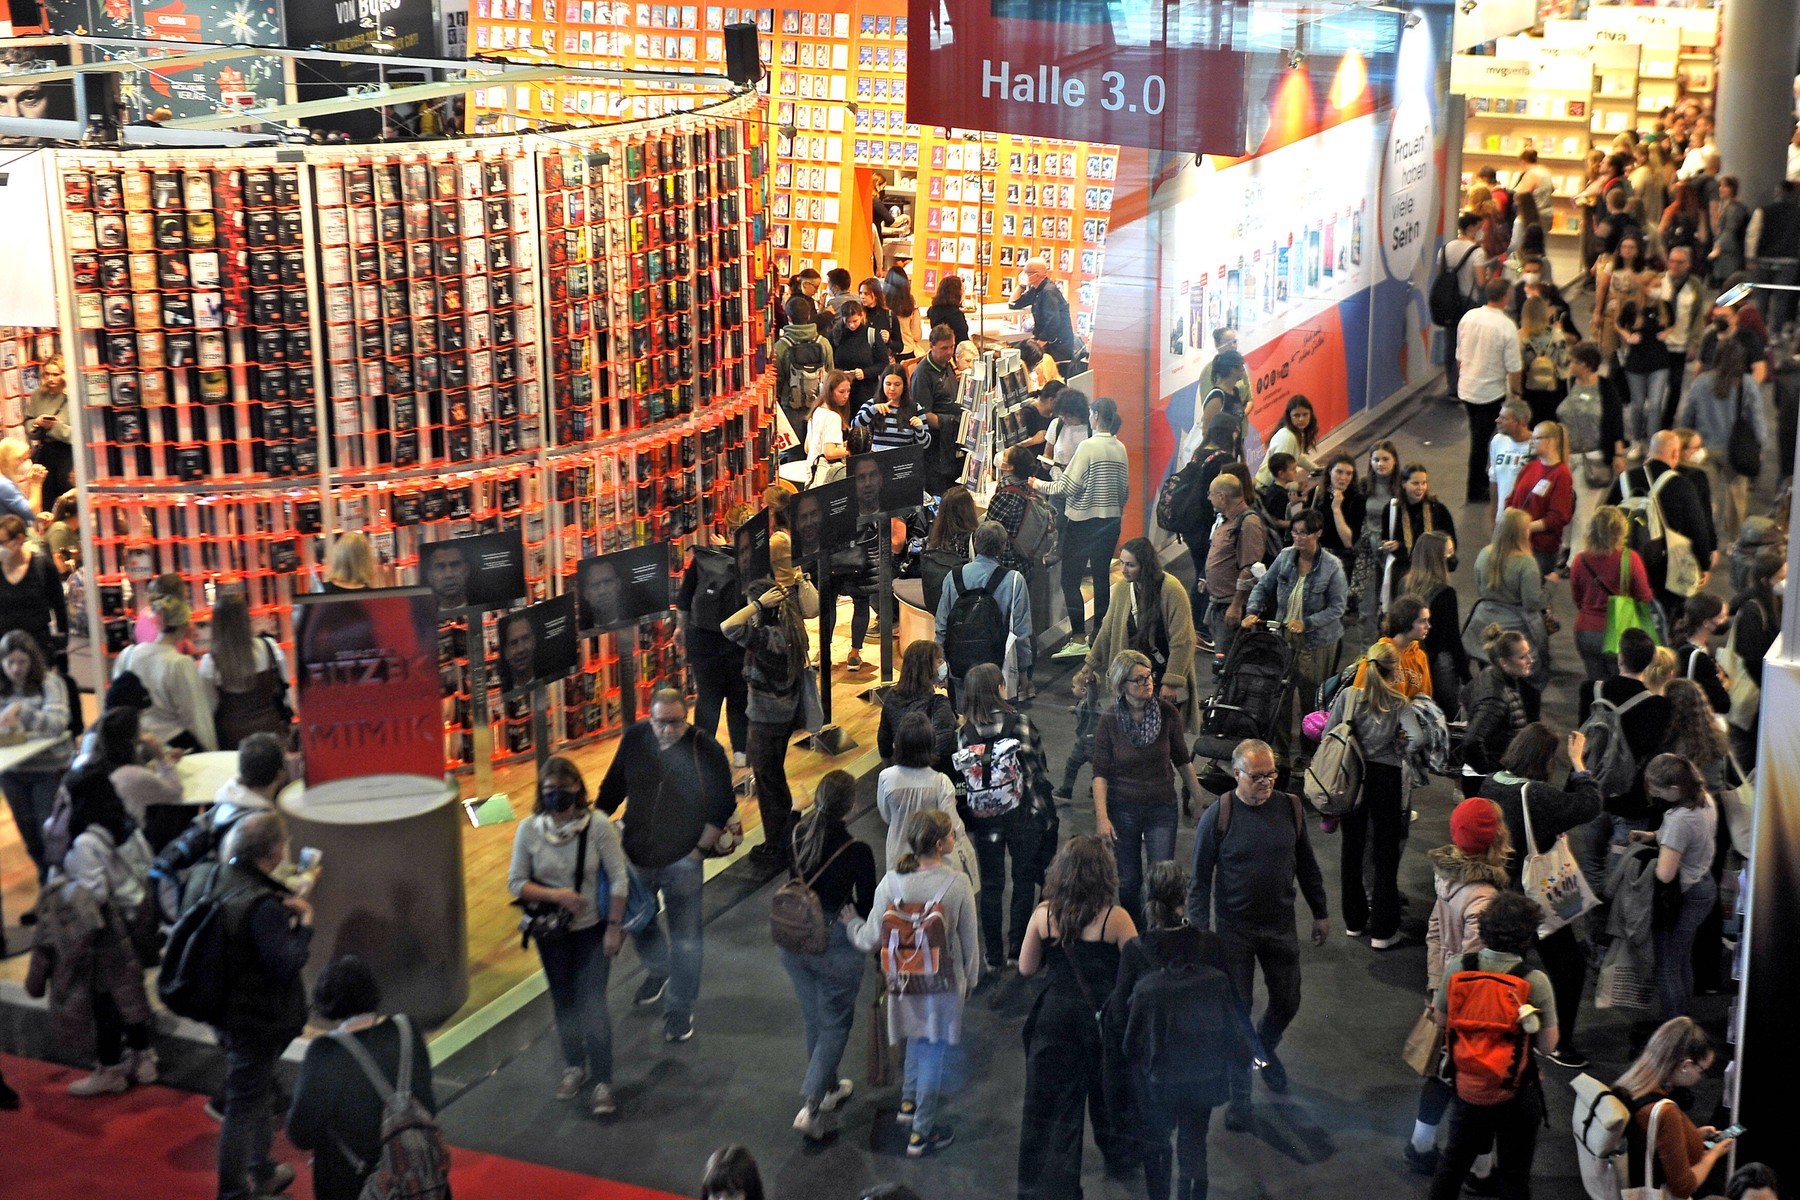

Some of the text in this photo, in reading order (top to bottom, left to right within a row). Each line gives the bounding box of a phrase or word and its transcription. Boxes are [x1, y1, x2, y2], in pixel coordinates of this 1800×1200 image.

[335, 1, 357, 24] VON
[1636, 15, 1667, 25] riva
[1596, 30, 1627, 42] riva
[1486, 65, 1534, 77] mvgverla
[982, 59, 1167, 115] Halle 3.0
[1394, 135, 1424, 163] Frauen
[1391, 193, 1414, 219] viele
